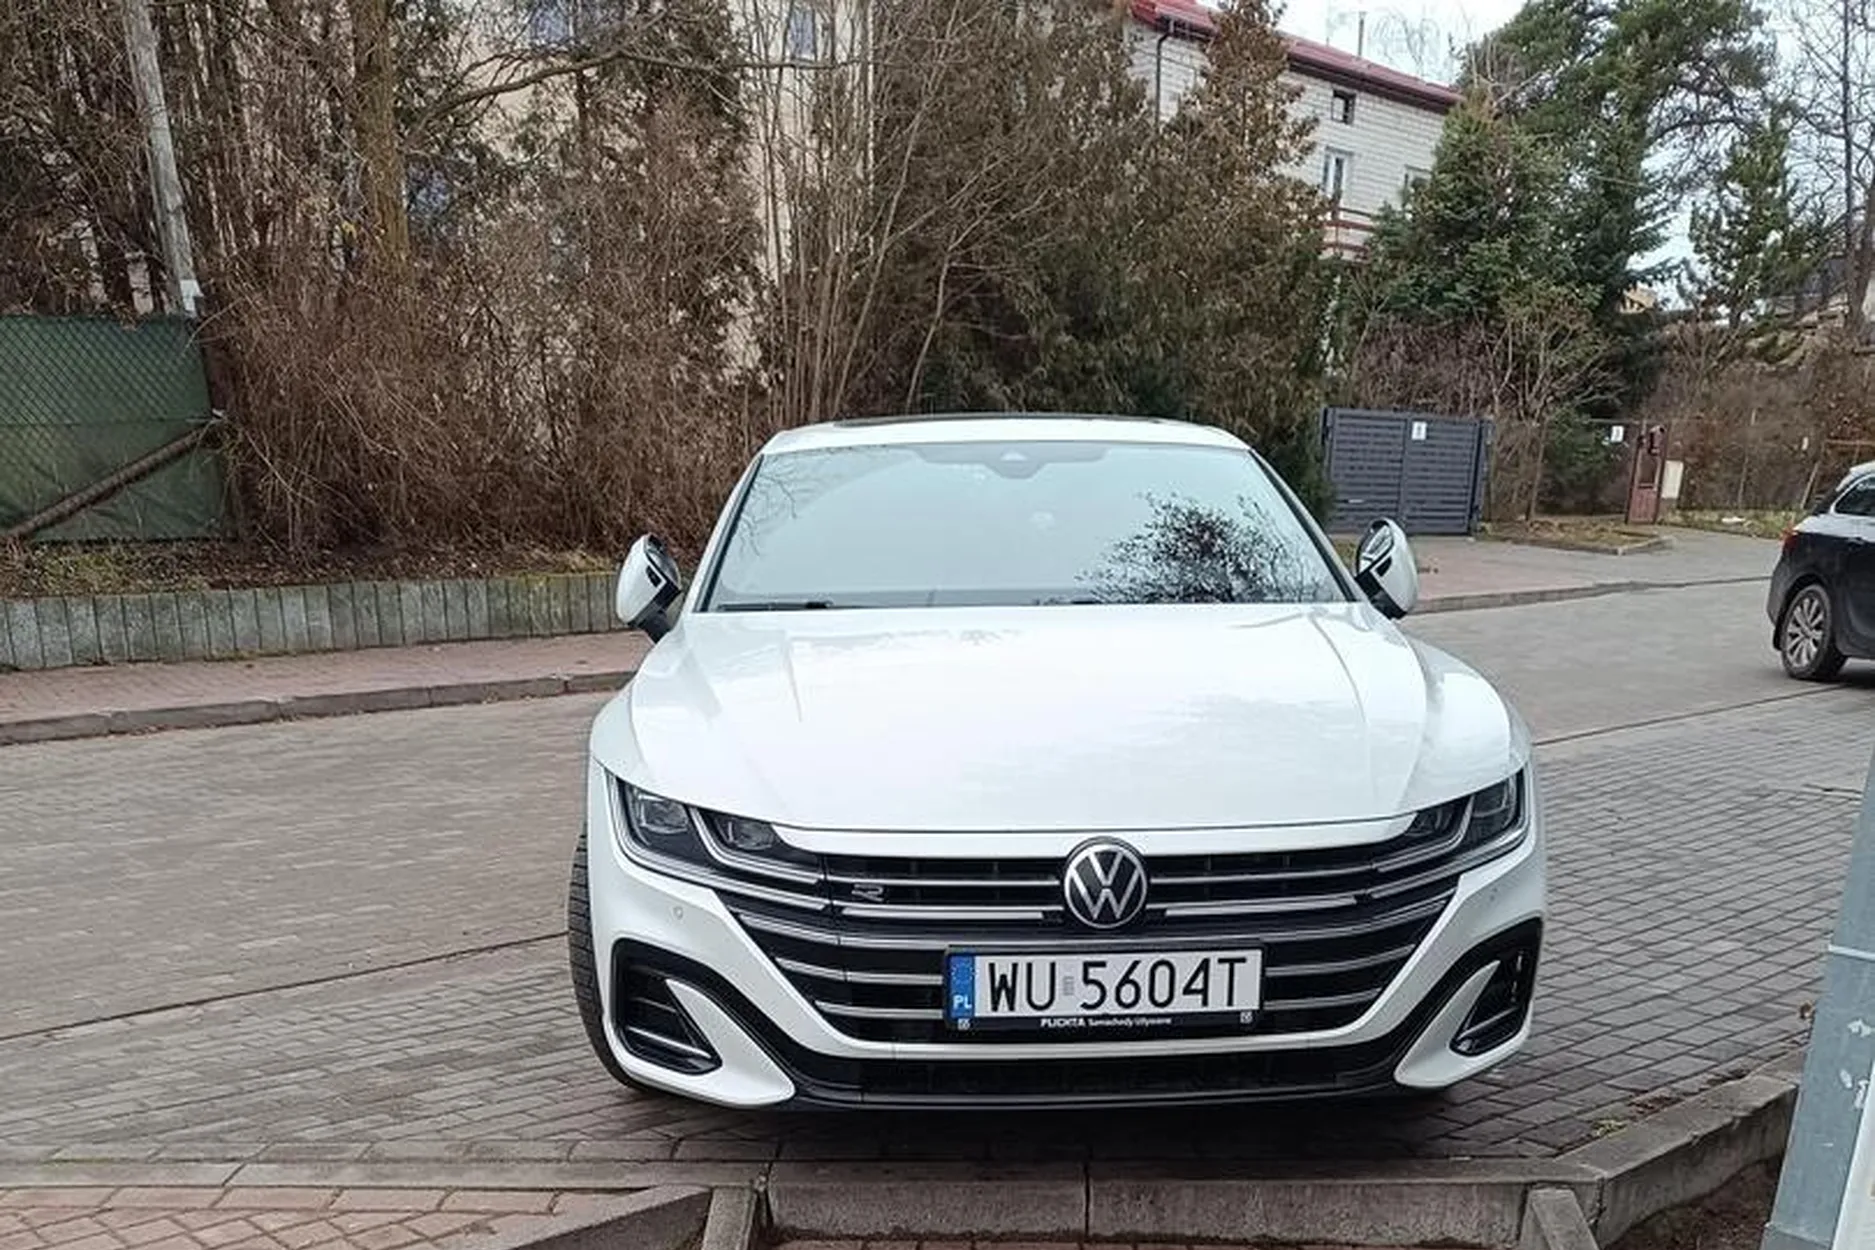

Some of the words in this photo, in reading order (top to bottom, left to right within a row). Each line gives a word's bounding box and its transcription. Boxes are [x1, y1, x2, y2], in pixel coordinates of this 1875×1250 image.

[988, 962, 1056, 1012] WU
[1080, 957, 1247, 1010] 5604T
[953, 995, 972, 1010] PL
